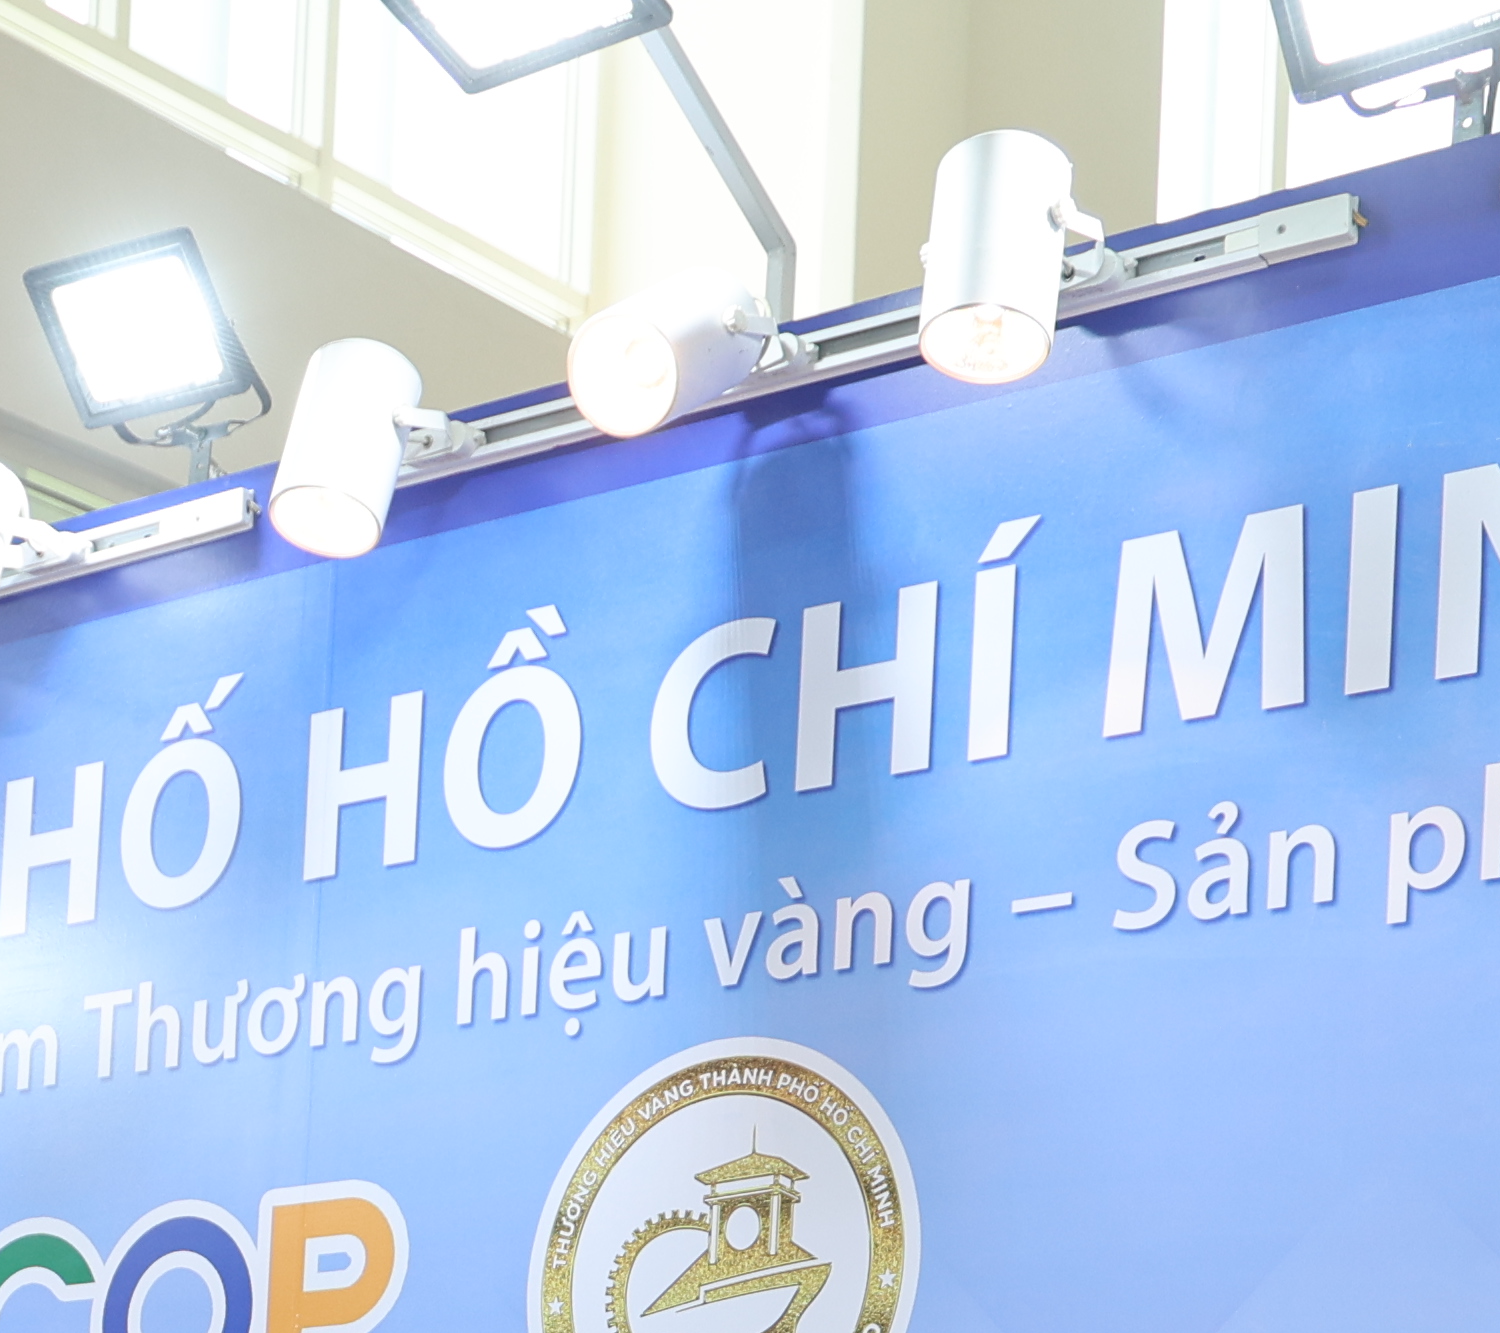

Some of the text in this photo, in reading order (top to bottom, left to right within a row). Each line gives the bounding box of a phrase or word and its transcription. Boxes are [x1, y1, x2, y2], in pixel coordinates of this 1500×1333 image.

[302, 605, 584, 883] HỒ
[650, 514, 1042, 812] CHÍ
[83, 962, 424, 1081] Thương
[455, 910, 668, 1037] hiệu
[704, 876, 971, 989] vàng
[1110, 800, 1340, 937] Sản
[551, 1169, 598, 1269] THƯƠNG
[637, 1078, 695, 1121] VÀNG
[699, 1062, 773, 1088] THÀNH
[866, 1164, 896, 1229] MINH
